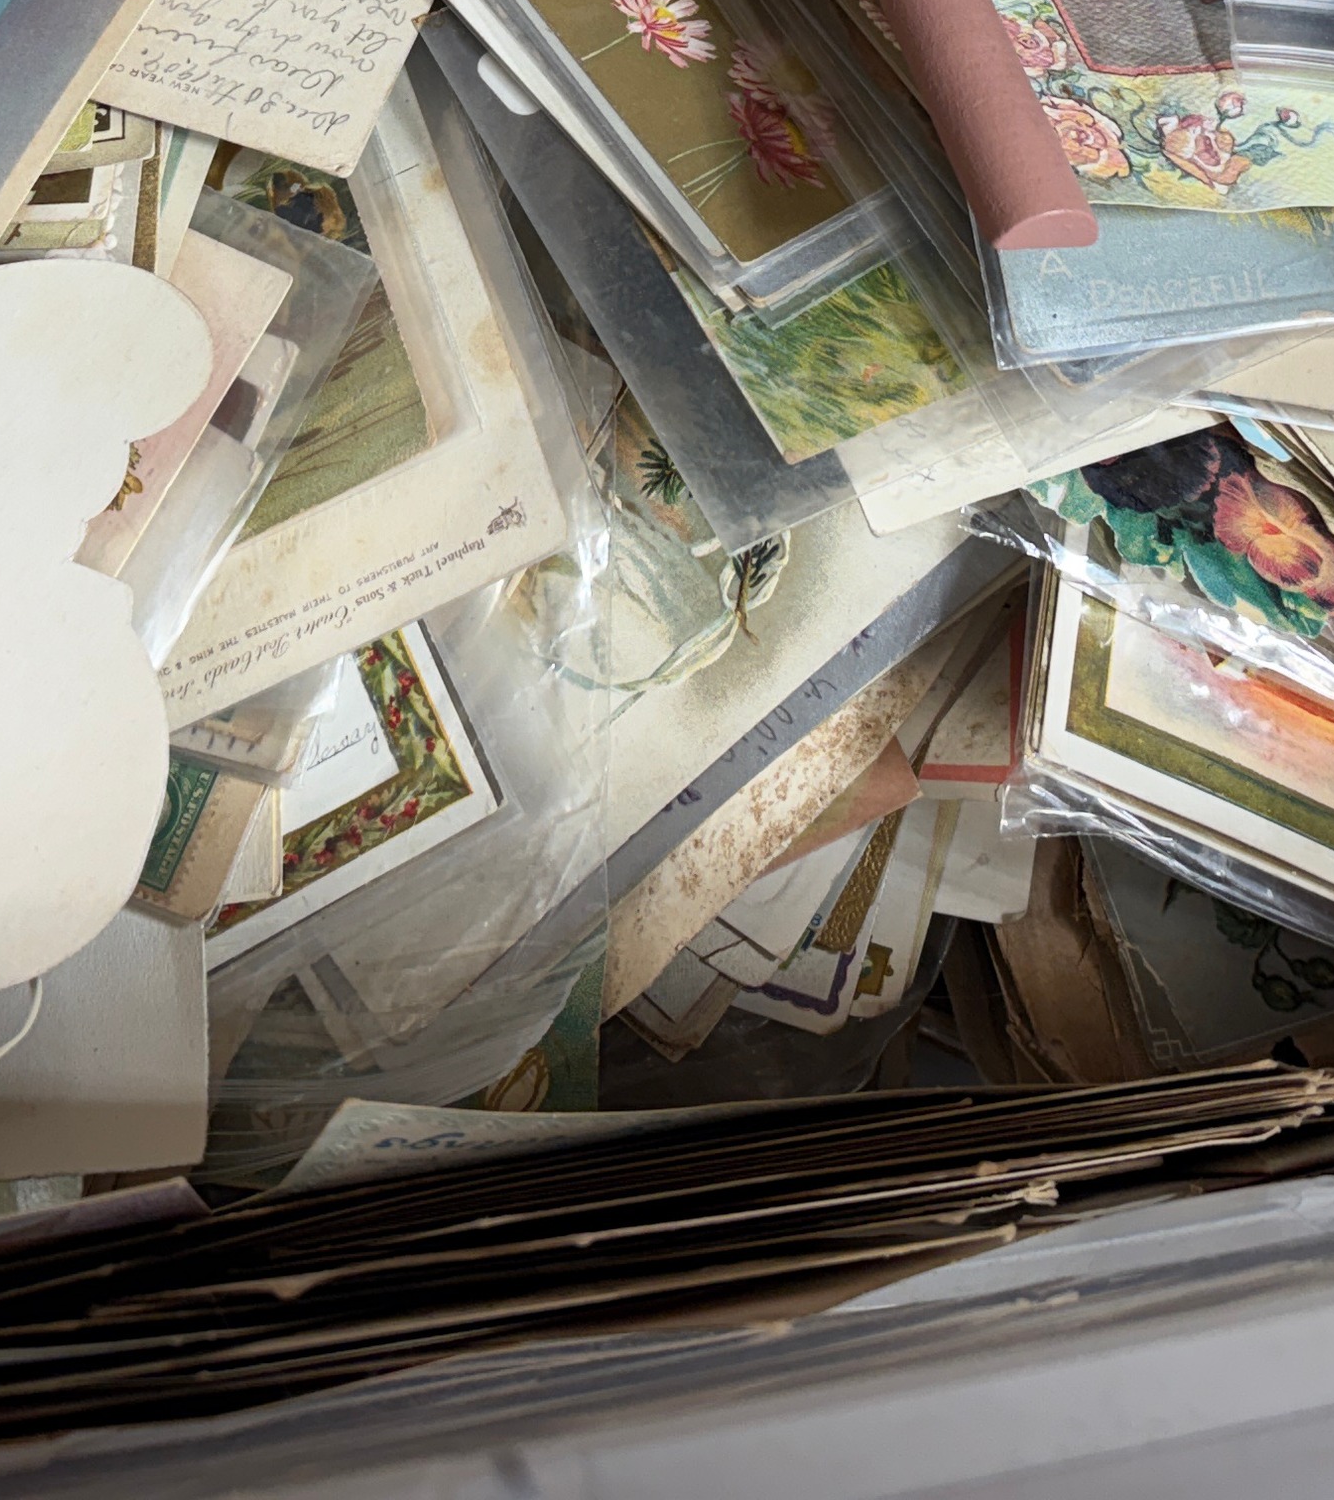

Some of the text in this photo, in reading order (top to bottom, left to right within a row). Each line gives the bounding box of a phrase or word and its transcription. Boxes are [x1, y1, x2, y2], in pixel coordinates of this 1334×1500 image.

[128, 68, 201, 95] NEW YEAR
[1038, 250, 1073, 281] A
[420, 541, 439, 557] ART
[435, 538, 486, 571] Raphael
[355, 552, 416, 587] PUBLISHERS
[400, 565, 434, 587] Tuck
[337, 583, 351, 596] TO
[386, 580, 398, 593] &
[302, 593, 333, 613] THEIR
[244, 608, 297, 639] MAJESTIES
[218, 635, 240, 652] THE
[188, 646, 215, 665] KING
